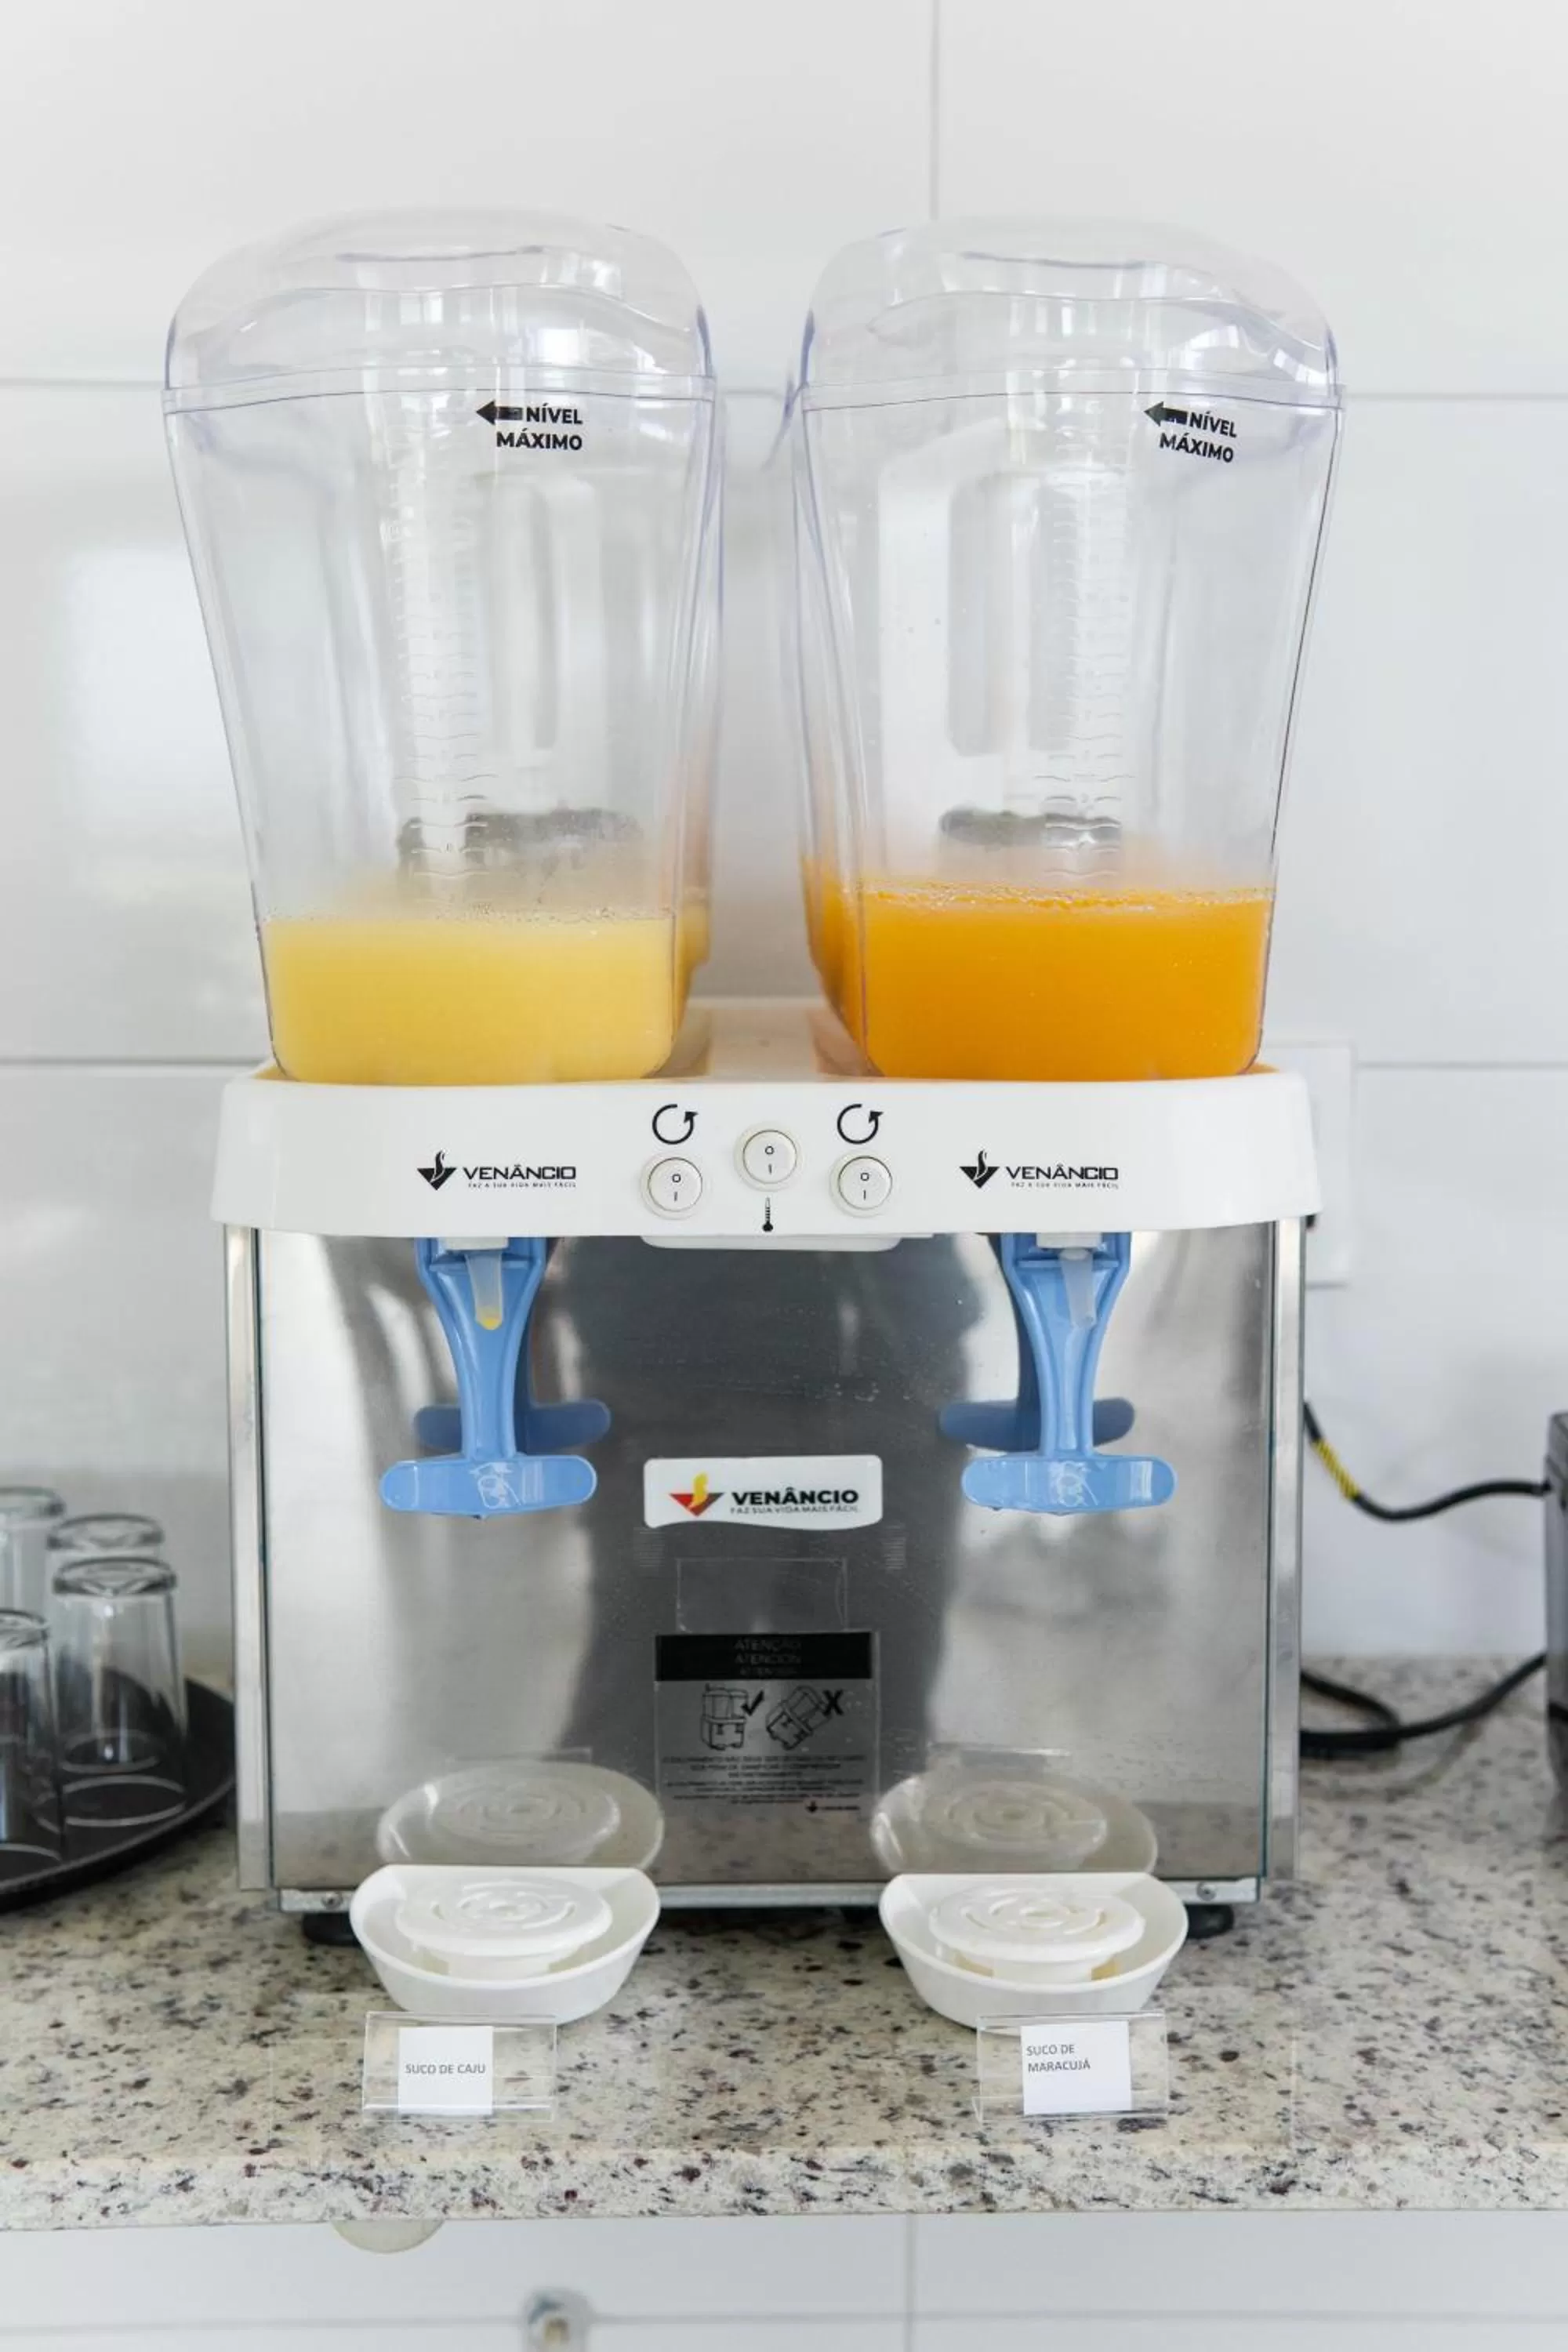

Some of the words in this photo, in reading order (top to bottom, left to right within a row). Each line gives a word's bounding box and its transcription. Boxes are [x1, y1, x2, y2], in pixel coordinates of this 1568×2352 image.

[526, 402, 583, 424] NÍVEL
[1189, 410, 1236, 438] NÍVEL
[496, 427, 583, 451] MÁXIMO
[1159, 432, 1234, 463] MÁXIMO
[463, 1163, 576, 1180] VENÂNCIO
[1006, 1162, 1119, 1181] VENÂNCIO
[731, 1486, 859, 1505] VENÂNCIO
[1026, 2044, 1058, 2056] SUCO
[1060, 2043, 1075, 2055] DE
[405, 2063, 436, 2074] SUCO
[439, 2063, 453, 2074] DE
[457, 2063, 486, 2074] CAJU
[1028, 2058, 1091, 2073] MARACUJÁ
